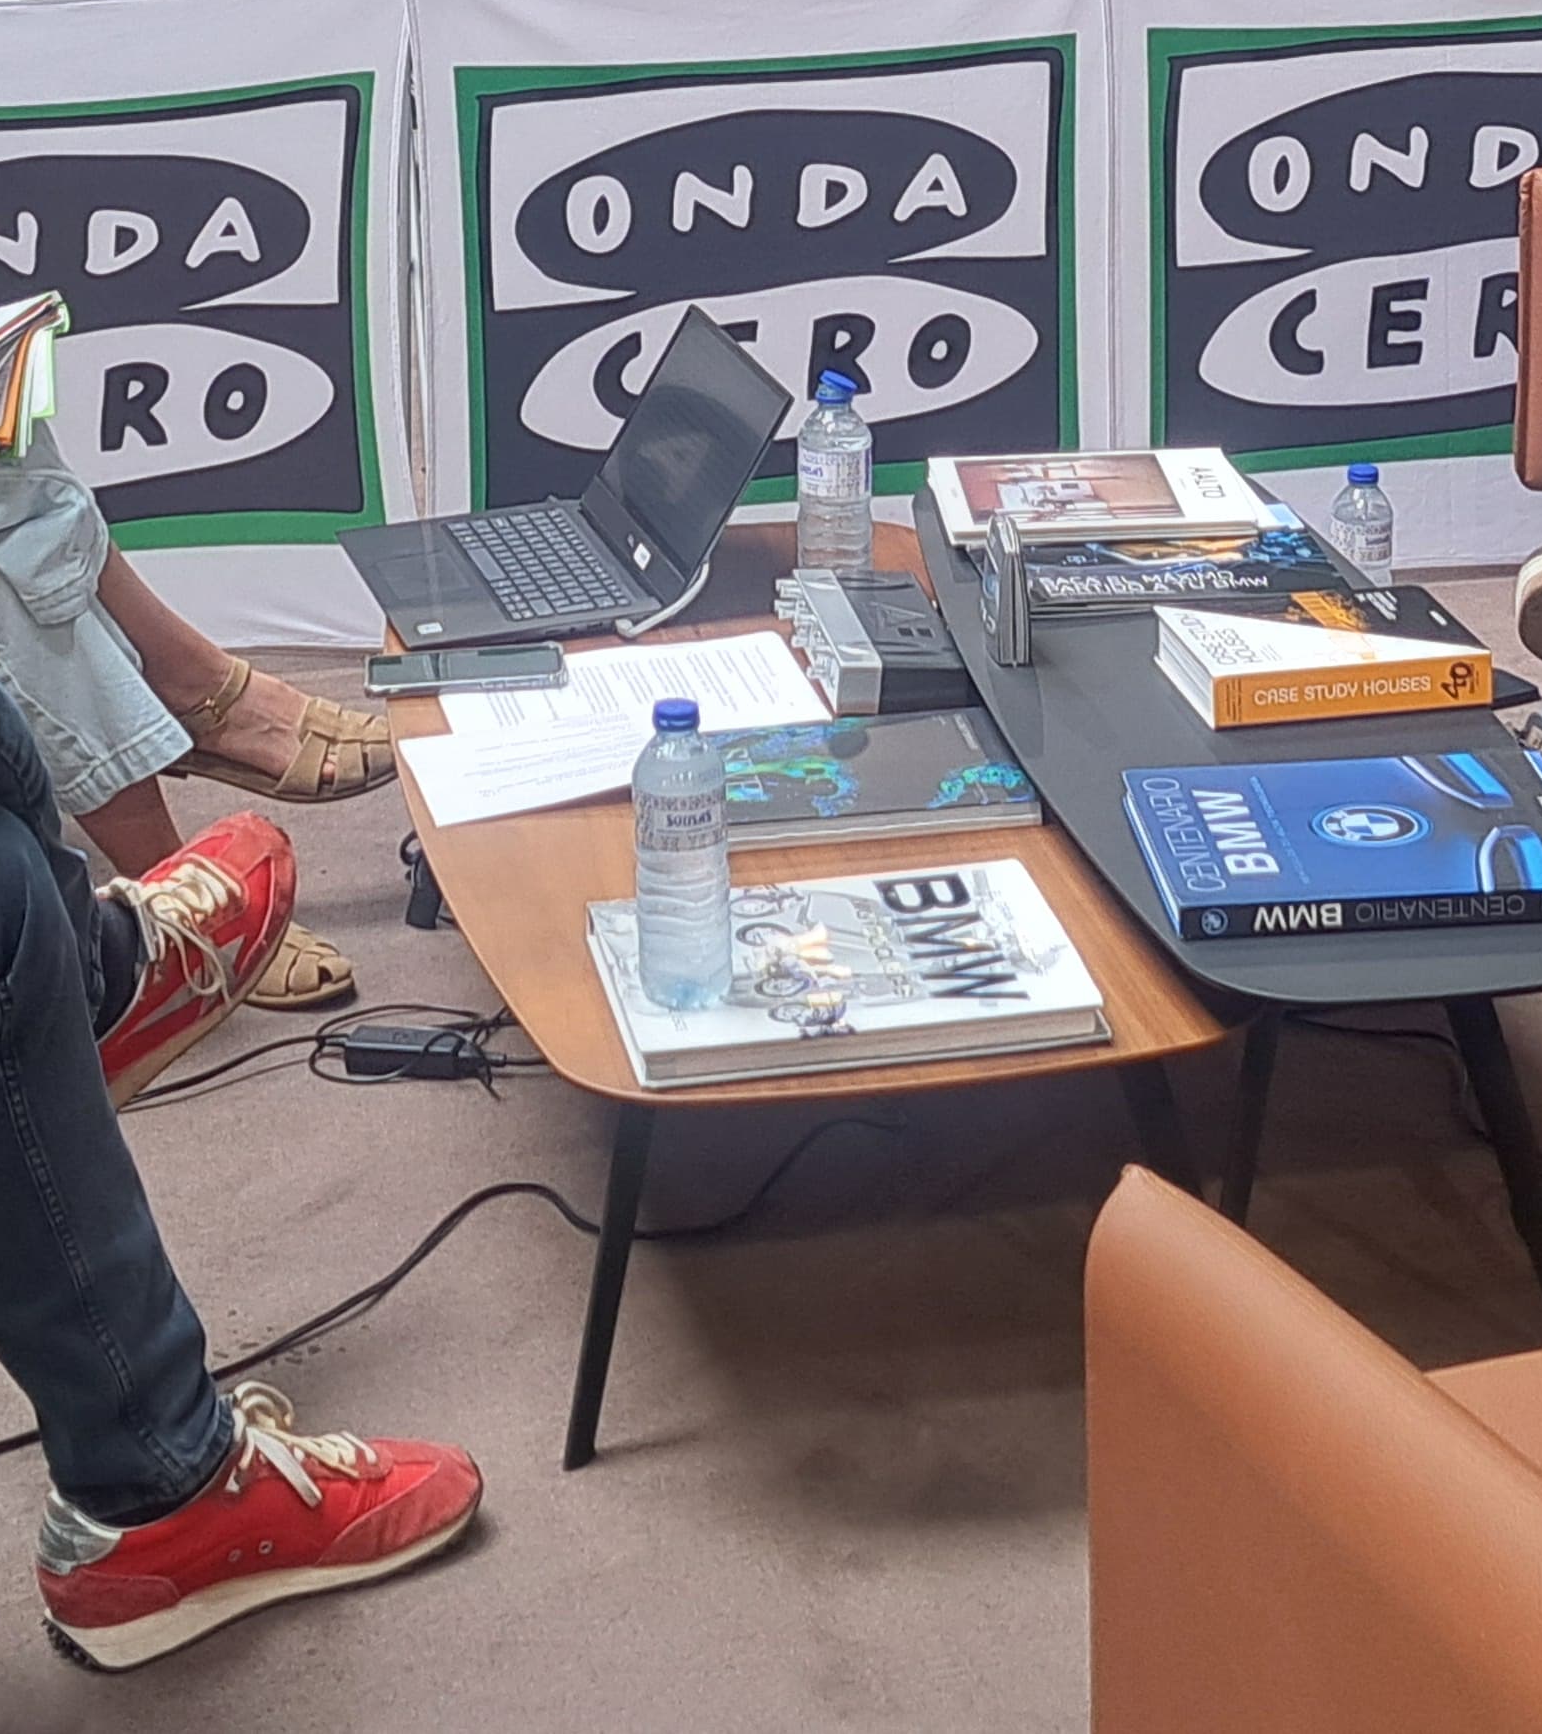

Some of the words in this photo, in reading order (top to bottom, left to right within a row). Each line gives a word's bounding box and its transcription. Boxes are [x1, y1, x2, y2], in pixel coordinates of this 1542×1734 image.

[566, 152, 968, 254] ONDA
[592, 312, 972, 421] CRO
[1269, 272, 1519, 376] CER
[100, 362, 268, 453] RO
[1254, 688, 1299, 706] CASE
[1304, 681, 1359, 701] STUDY
[1362, 675, 1432, 697] HOUSES
[1142, 777, 1227, 892] CENTENARIO
[1191, 789, 1280, 876] BMW
[872, 872, 1032, 1001] BMW
[1253, 902, 1343, 933] BMW
[1354, 894, 1526, 924] CENTENARIO
